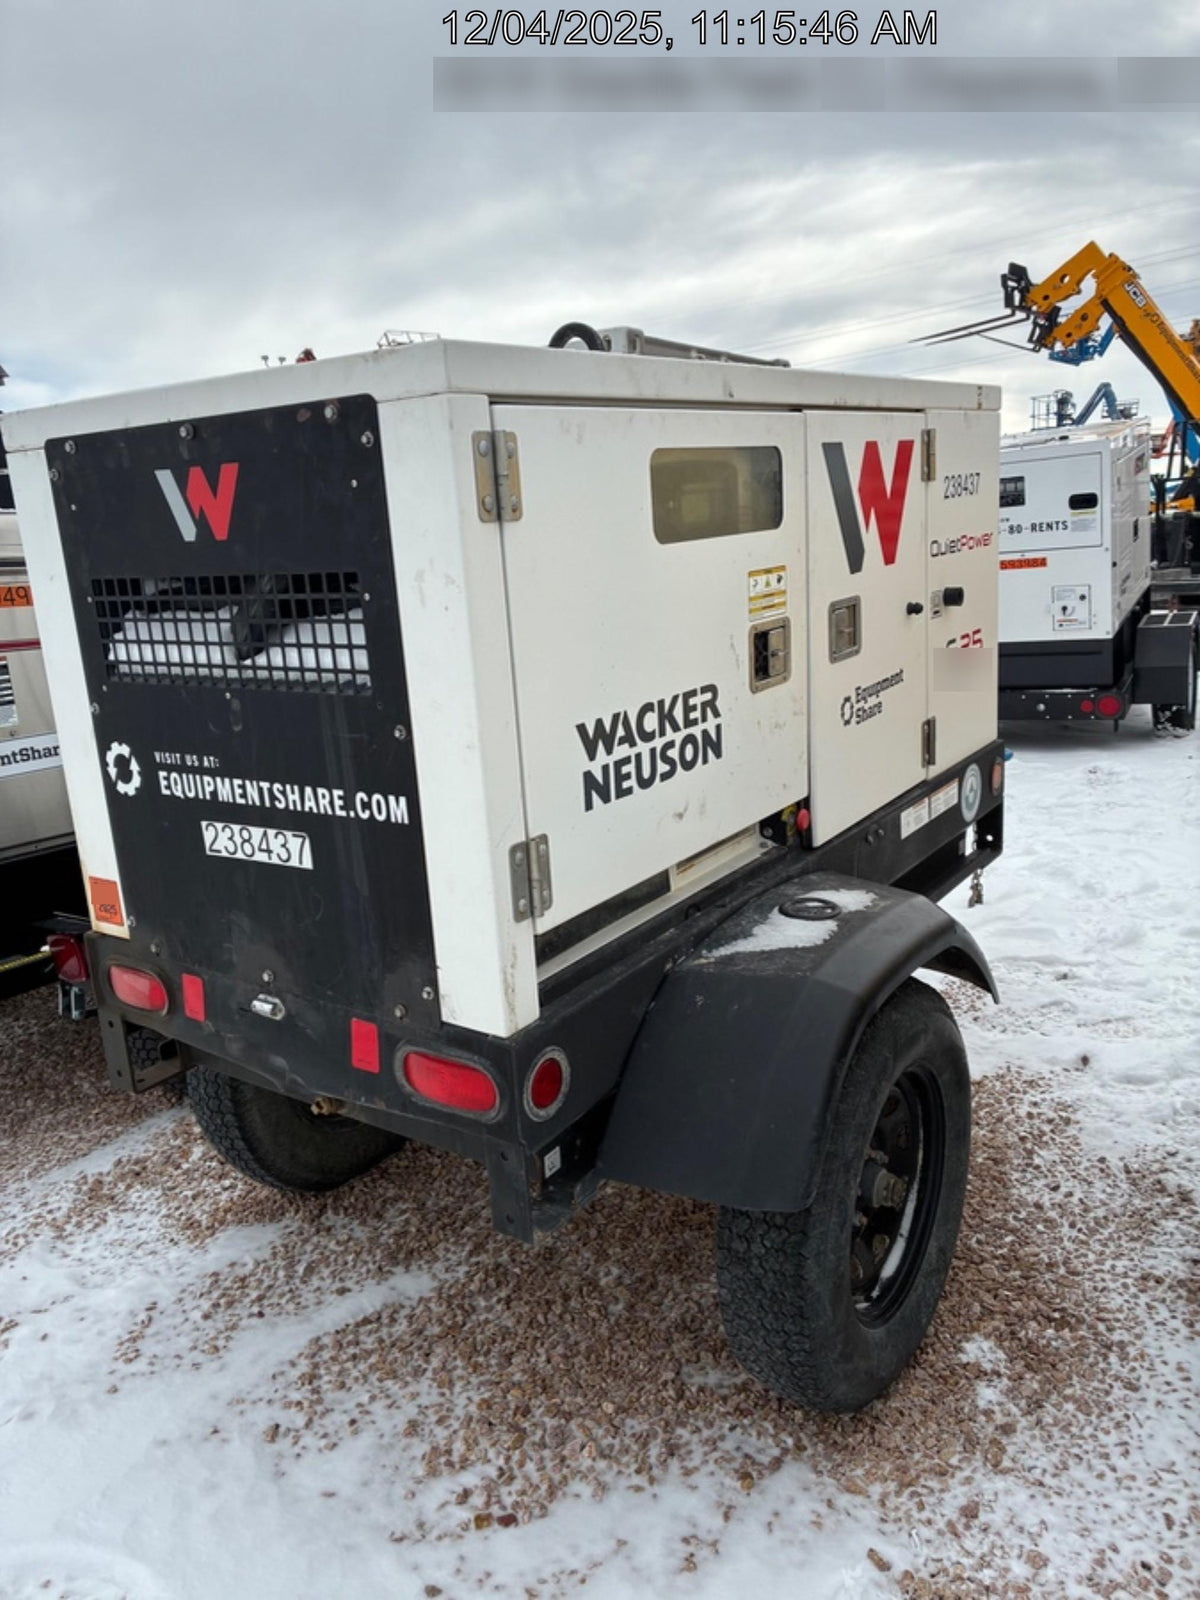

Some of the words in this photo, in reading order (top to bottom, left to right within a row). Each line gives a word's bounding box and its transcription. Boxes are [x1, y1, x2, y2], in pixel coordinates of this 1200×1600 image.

[1124, 281, 1147, 309] JCB
[943, 472, 981, 499] 238437
[930, 532, 993, 557] QuietPower
[855, 668, 904, 704] Equipment
[575, 683, 722, 762] WACKER
[855, 701, 883, 725] Share
[154, 751, 181, 765] VISIT
[185, 754, 199, 767] US
[203, 756, 219, 768] AT:
[582, 723, 723, 813] NEUSON
[158, 770, 410, 825] EQUIPMENTSHARE.COM
[204, 822, 307, 866] 238437
